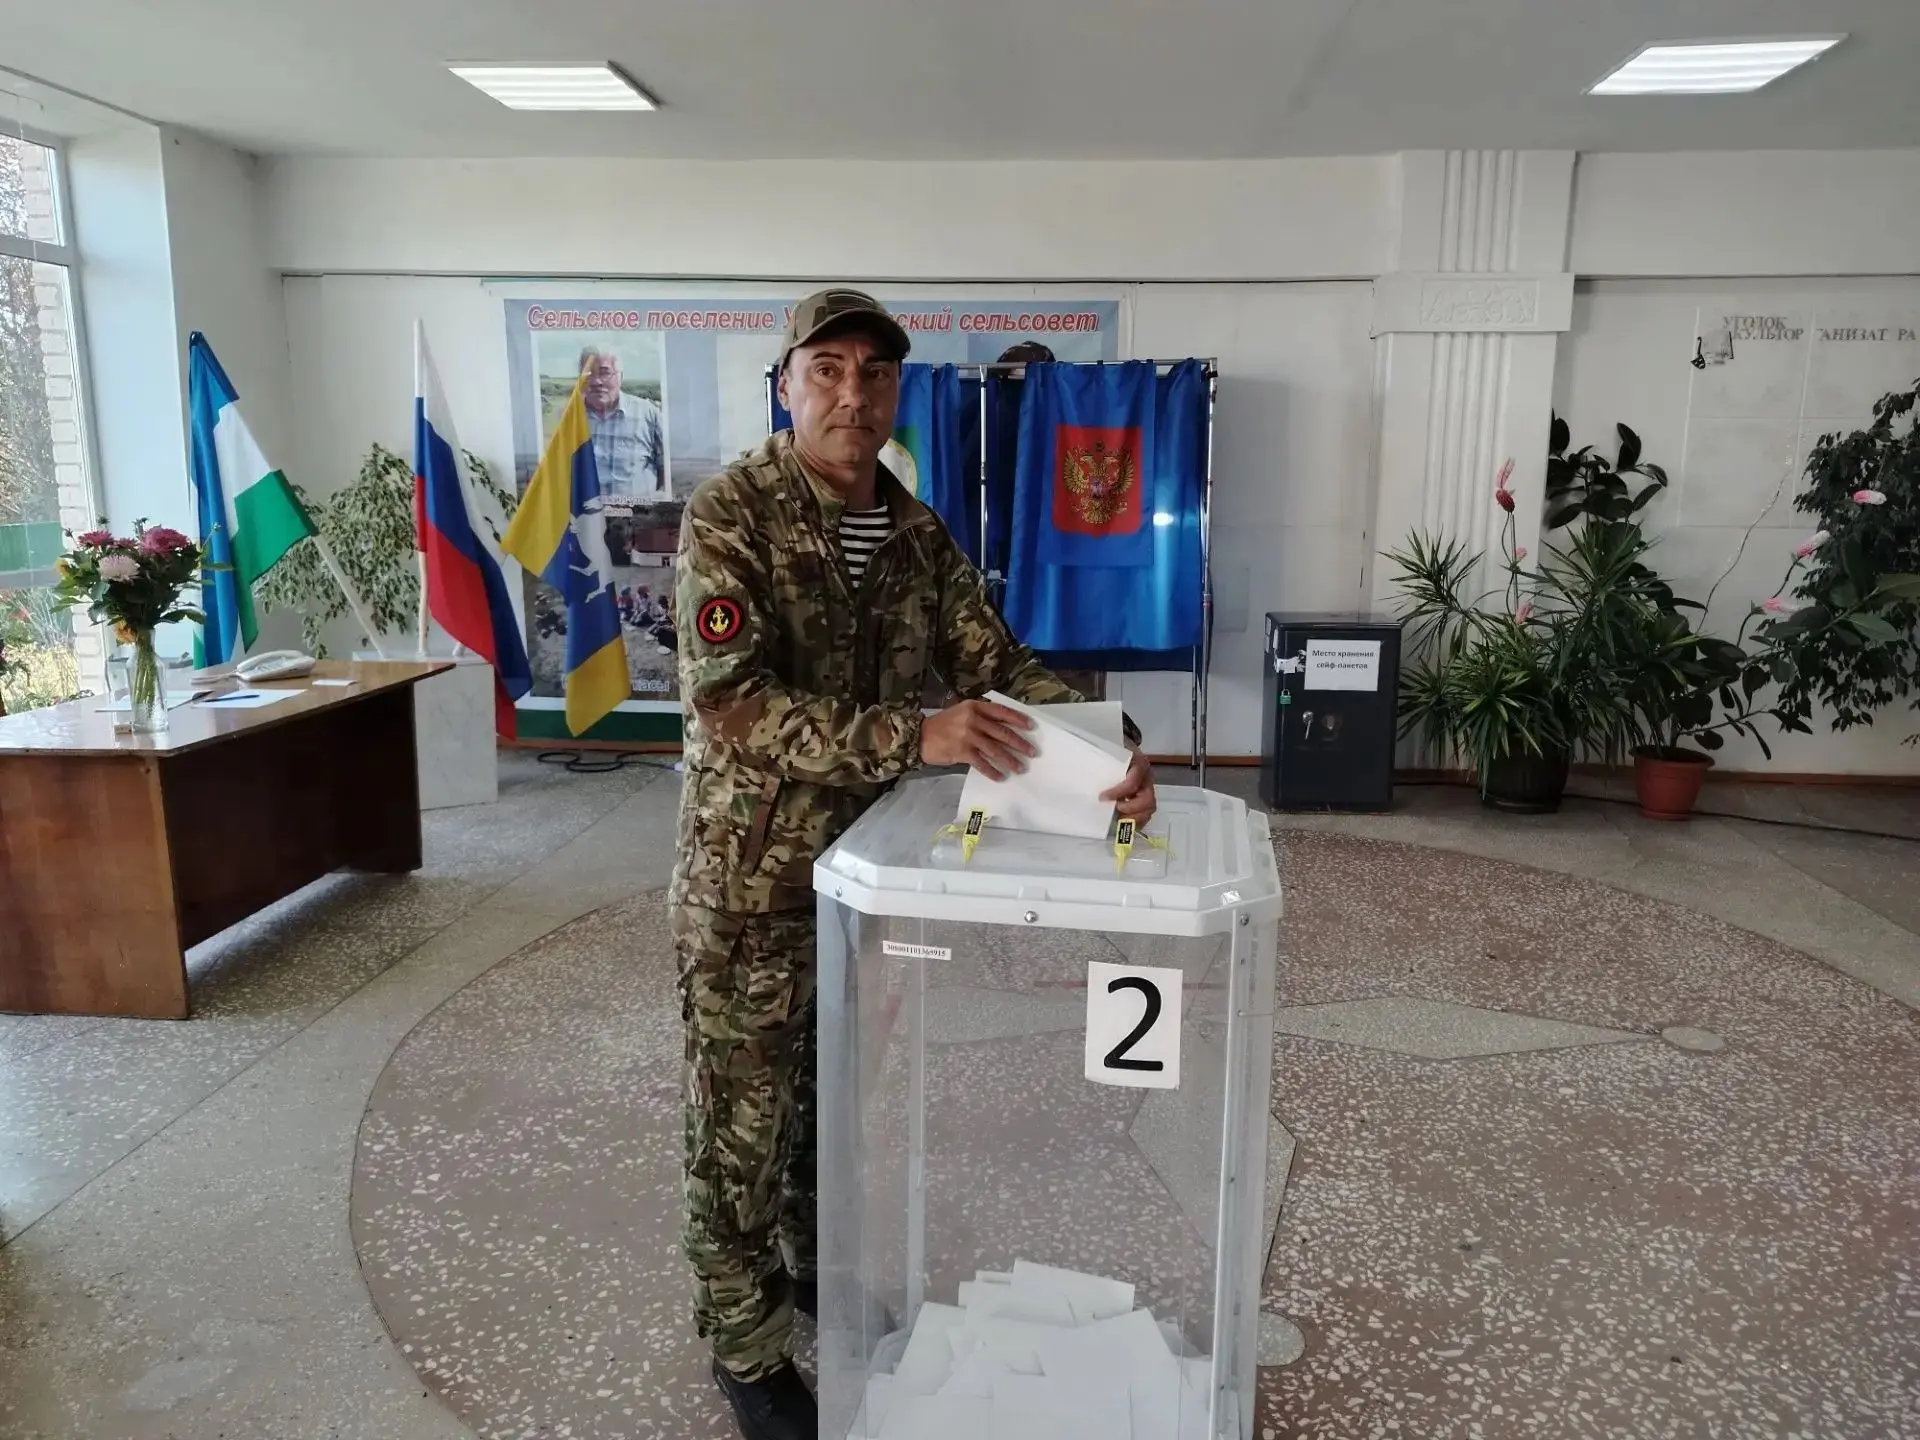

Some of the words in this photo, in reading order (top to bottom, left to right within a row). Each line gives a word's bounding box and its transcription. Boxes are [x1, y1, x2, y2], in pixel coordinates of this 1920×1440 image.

[528, 304, 640, 330] Сельское
[647, 308, 776, 331] поселение
[889, 305, 953, 333] ский
[959, 311, 1099, 333] сельсовет
[1312, 649, 1336, 657] Место
[1316, 661, 1368, 670] сейф-пакетов
[1104, 976, 1164, 1072] 2
